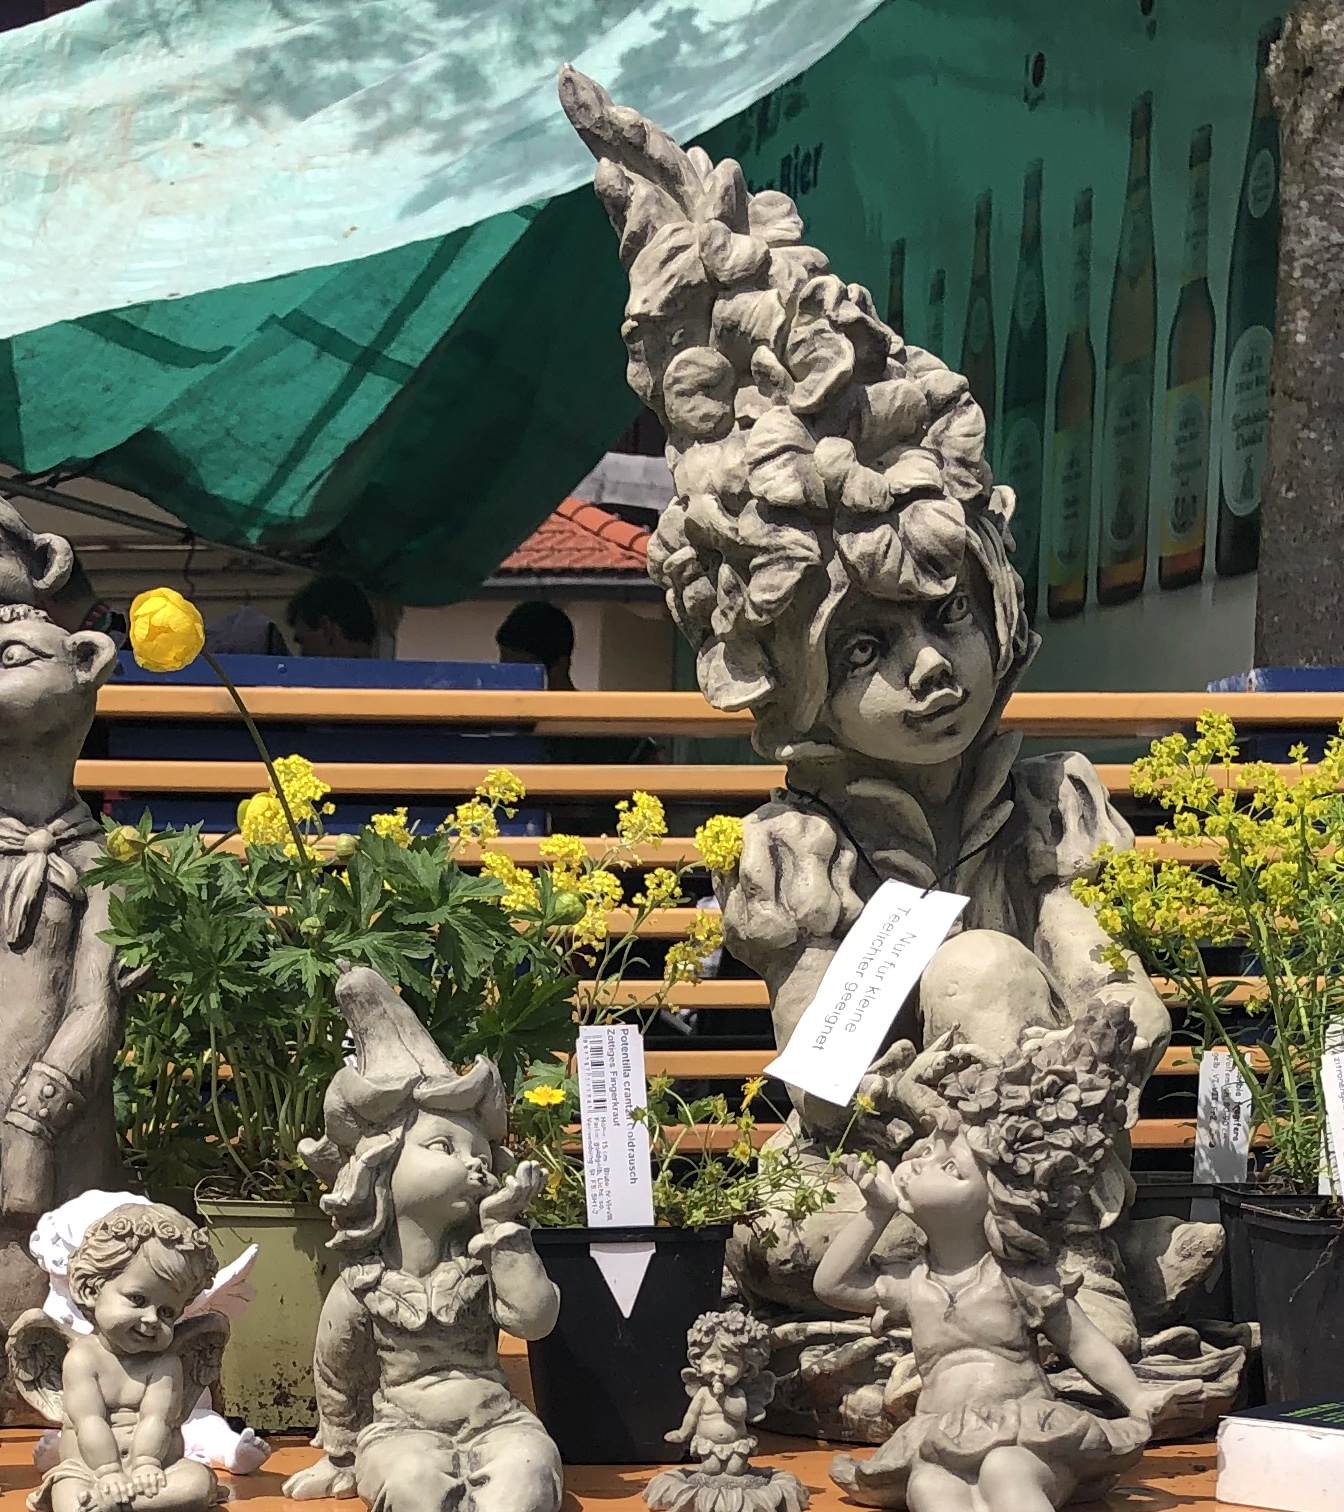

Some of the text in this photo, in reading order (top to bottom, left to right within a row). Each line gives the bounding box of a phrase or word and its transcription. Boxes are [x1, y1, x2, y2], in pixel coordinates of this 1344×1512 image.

[889, 929, 916, 959] Nur
[809, 902, 911, 1054] Teelichter geeignet
[843, 983, 880, 1035] kleine
[605, 1027, 621, 1127] Zottiges Fingerkraut
[619, 1028, 631, 1078] Potentilla
